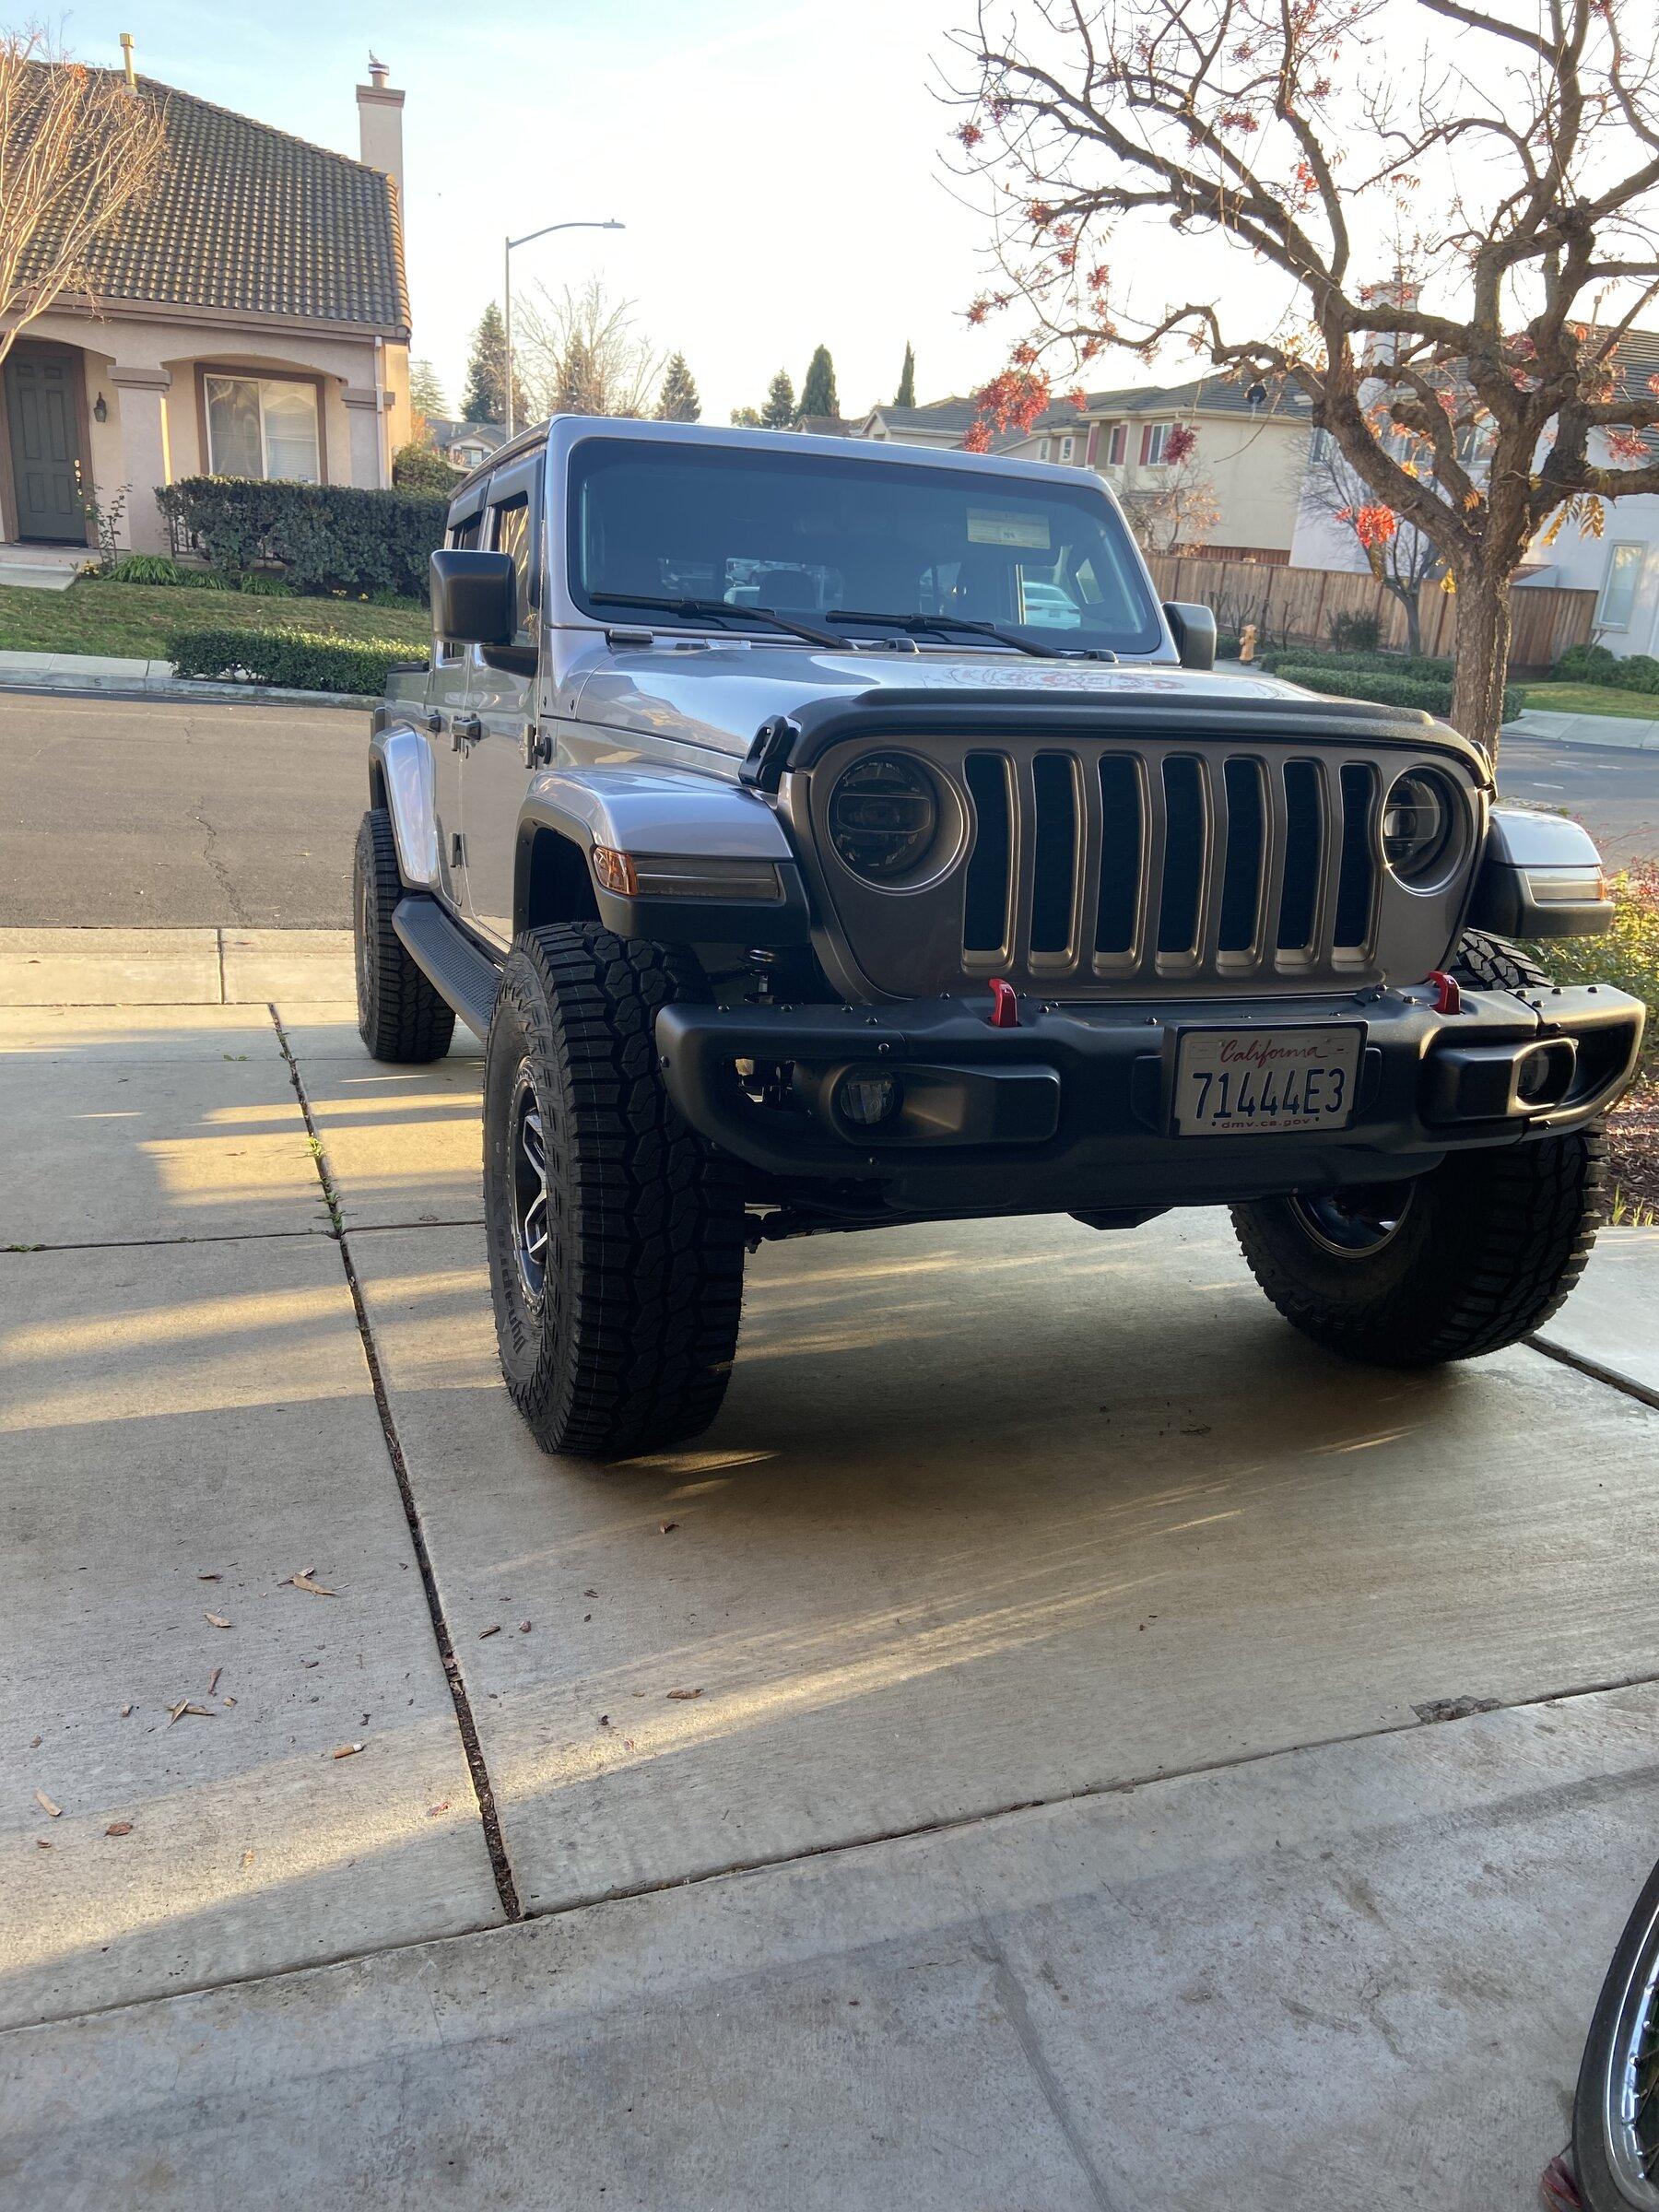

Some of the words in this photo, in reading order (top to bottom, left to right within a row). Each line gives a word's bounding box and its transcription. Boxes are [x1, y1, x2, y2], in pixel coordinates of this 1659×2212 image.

[1220, 1039, 1328, 1068] California
[1193, 1067, 1346, 1119] 71444E3
[1221, 1117, 1311, 1129] dmv.ca.gov
